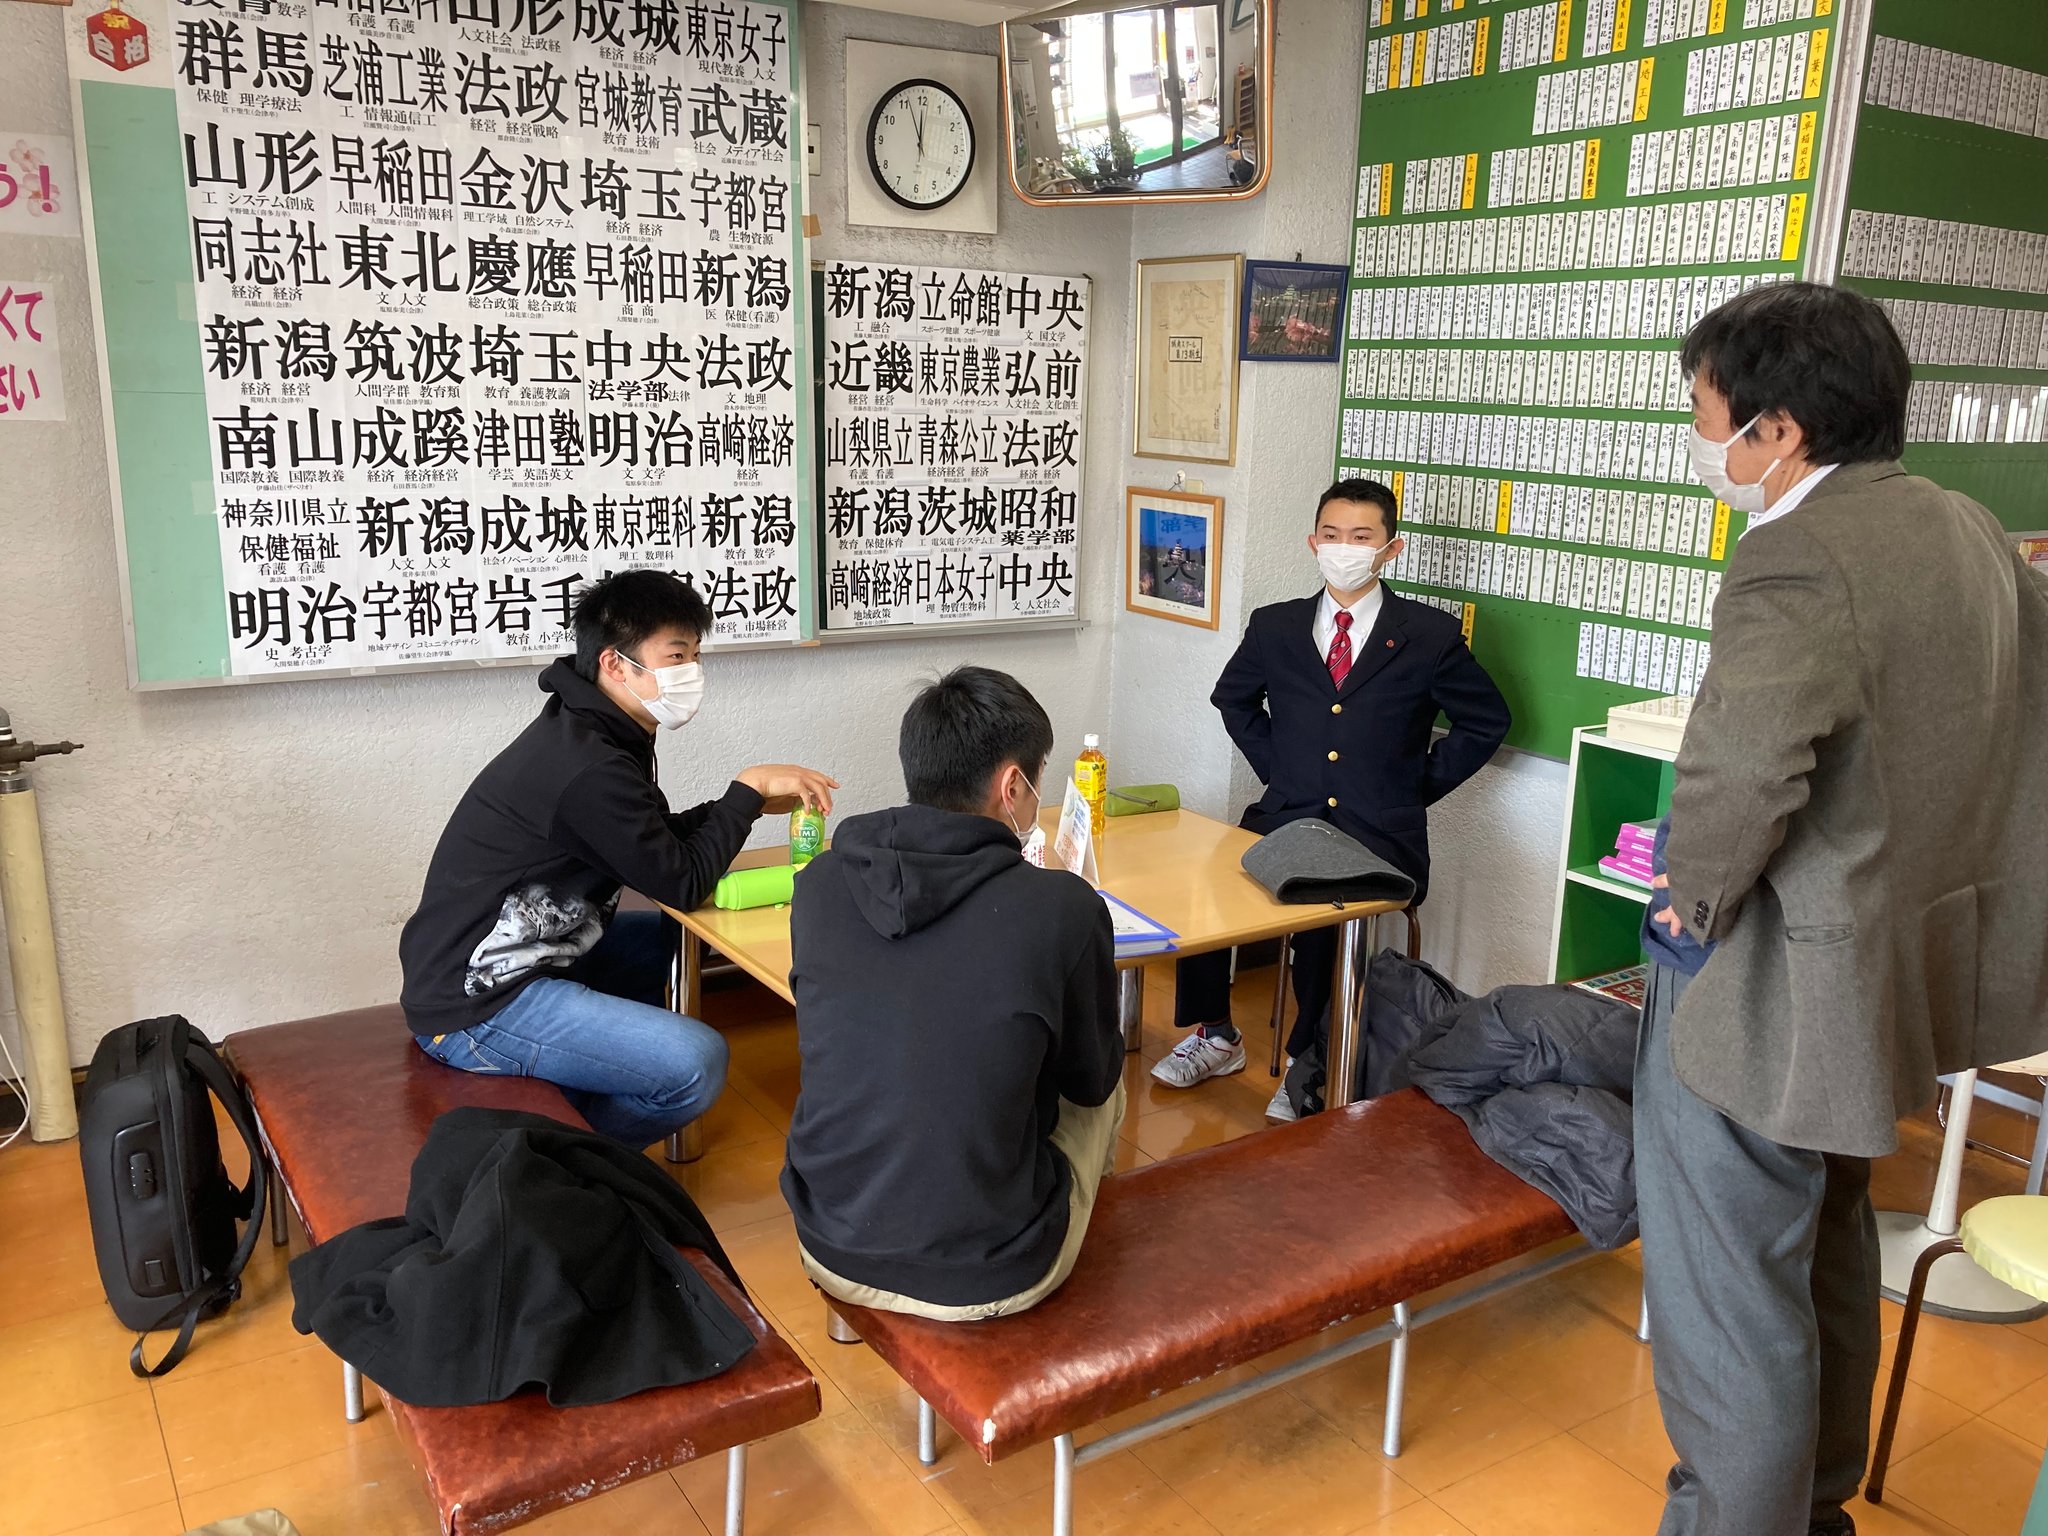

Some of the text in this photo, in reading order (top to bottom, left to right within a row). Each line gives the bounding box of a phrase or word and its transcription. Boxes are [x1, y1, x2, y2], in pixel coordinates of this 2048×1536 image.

[91, 31, 146, 63] 合格
[458, 27, 512, 46] 人文社会
[521, 35, 561, 54] 法政経
[572, 0, 680, 55] 成城
[685, 2, 785, 66] 東京女子
[176, 18, 314, 97] 群馬
[320, 33, 448, 112] 芝浦工業
[698, 60, 745, 78] 現代教養
[753, 67, 776, 82] 人文
[1810, 42, 1823, 88] 千葉大
[197, 88, 302, 112] 保健 理学療法
[454, 51, 568, 124] 法政
[575, 65, 682, 136] 宮城教育
[900, 100, 909, 110] 11
[918, 96, 928, 106] 12
[938, 105, 942, 114] 1
[340, 106, 436, 126] 工 情報通信工
[470, 117, 558, 139] 経営 経営戦略
[688, 82, 787, 150] 武蔵
[878, 135, 884, 144] 9
[884, 116, 895, 125] 10
[950, 122, 954, 132] 2
[184, 122, 322, 194] 山形
[330, 133, 453, 205] 早稲田
[694, 141, 784, 162] 社会 メディア社会
[883, 160, 888, 169] 8
[946, 166, 952, 176] 4
[954, 145, 958, 154] 3
[202, 192, 315, 212] 工 システム創成
[460, 146, 574, 216] 金沢
[580, 158, 686, 221] 埼玉
[690, 168, 788, 233] 宇都宮
[896, 176, 901, 185] 7
[914, 184, 918, 194] 6
[932, 180, 936, 190] 5
[336, 200, 454, 222] 人間科 人間情報科
[464, 211, 574, 230] 理工学域 自然システム
[192, 216, 331, 286] 同志社
[335, 224, 460, 293] 東北
[729, 230, 774, 246] 生物資源
[466, 232, 577, 298] 慶應
[584, 241, 687, 304] 早稲田
[692, 249, 791, 312] 新潟
[231, 284, 303, 301] 経済 経済
[468, 296, 577, 314] 総合政策 総合政策
[705, 308, 716, 320] 医
[827, 262, 916, 322] 新潟
[920, 272, 1002, 326] 立命館
[1006, 276, 1084, 332] 中央
[204, 314, 337, 382] 新潟
[344, 318, 465, 384] 筑波
[469, 323, 582, 386] 埼玉
[586, 328, 690, 382] 中央
[696, 332, 793, 392] 法政
[828, 340, 914, 394] 近畿
[919, 343, 1000, 396] 東京農業
[240, 382, 310, 396] 経済 経営
[356, 384, 460, 400] 人間学群 教育類
[484, 386, 570, 400] 教育 養護教諭
[588, 380, 668, 402] 法学部
[1005, 348, 1082, 400] 弘前
[212, 404, 343, 470] 南山
[352, 405, 470, 468] 成蹊
[473, 408, 585, 468] 津田塾
[588, 410, 694, 468] 明治
[698, 412, 794, 468] 高崎経済
[828, 416, 914, 468] 山梨県立
[918, 414, 998, 466] 青森公立
[1002, 418, 1078, 469] 法政
[220, 470, 345, 484] 国際教養 国際教養
[367, 468, 459, 482] 経済 経済経営
[488, 468, 574, 481] 学芸 英語英文
[221, 498, 350, 529] 神奈川県立
[356, 496, 475, 558] 新潟
[480, 494, 590, 554] 成城
[593, 492, 696, 550] 東京理科
[700, 492, 796, 548] 新潟
[828, 486, 914, 538] 新潟
[918, 485, 998, 536] 茨城
[1000, 486, 1076, 530] 昭和
[238, 532, 341, 563] 保健福祉
[483, 553, 588, 566] 社会イノベーション 心理社会
[724, 547, 776, 560] 教育 数学
[1000, 528, 1076, 546] 薬学部
[258, 560, 326, 576] 看護 看護
[703, 566, 797, 620] 法政
[830, 556, 912, 610] 高崎経済
[916, 553, 995, 604] 日本女子
[1000, 551, 1073, 601] 中央
[228, 581, 357, 650] 明治
[362, 577, 478, 640] 宇都宮
[484, 572, 584, 633] 岩手
[714, 622, 738, 634] 経営
[265, 645, 332, 662] 史 考古学
[368, 642, 412, 652] 地域デザイン
[506, 633, 530, 646] 教育
